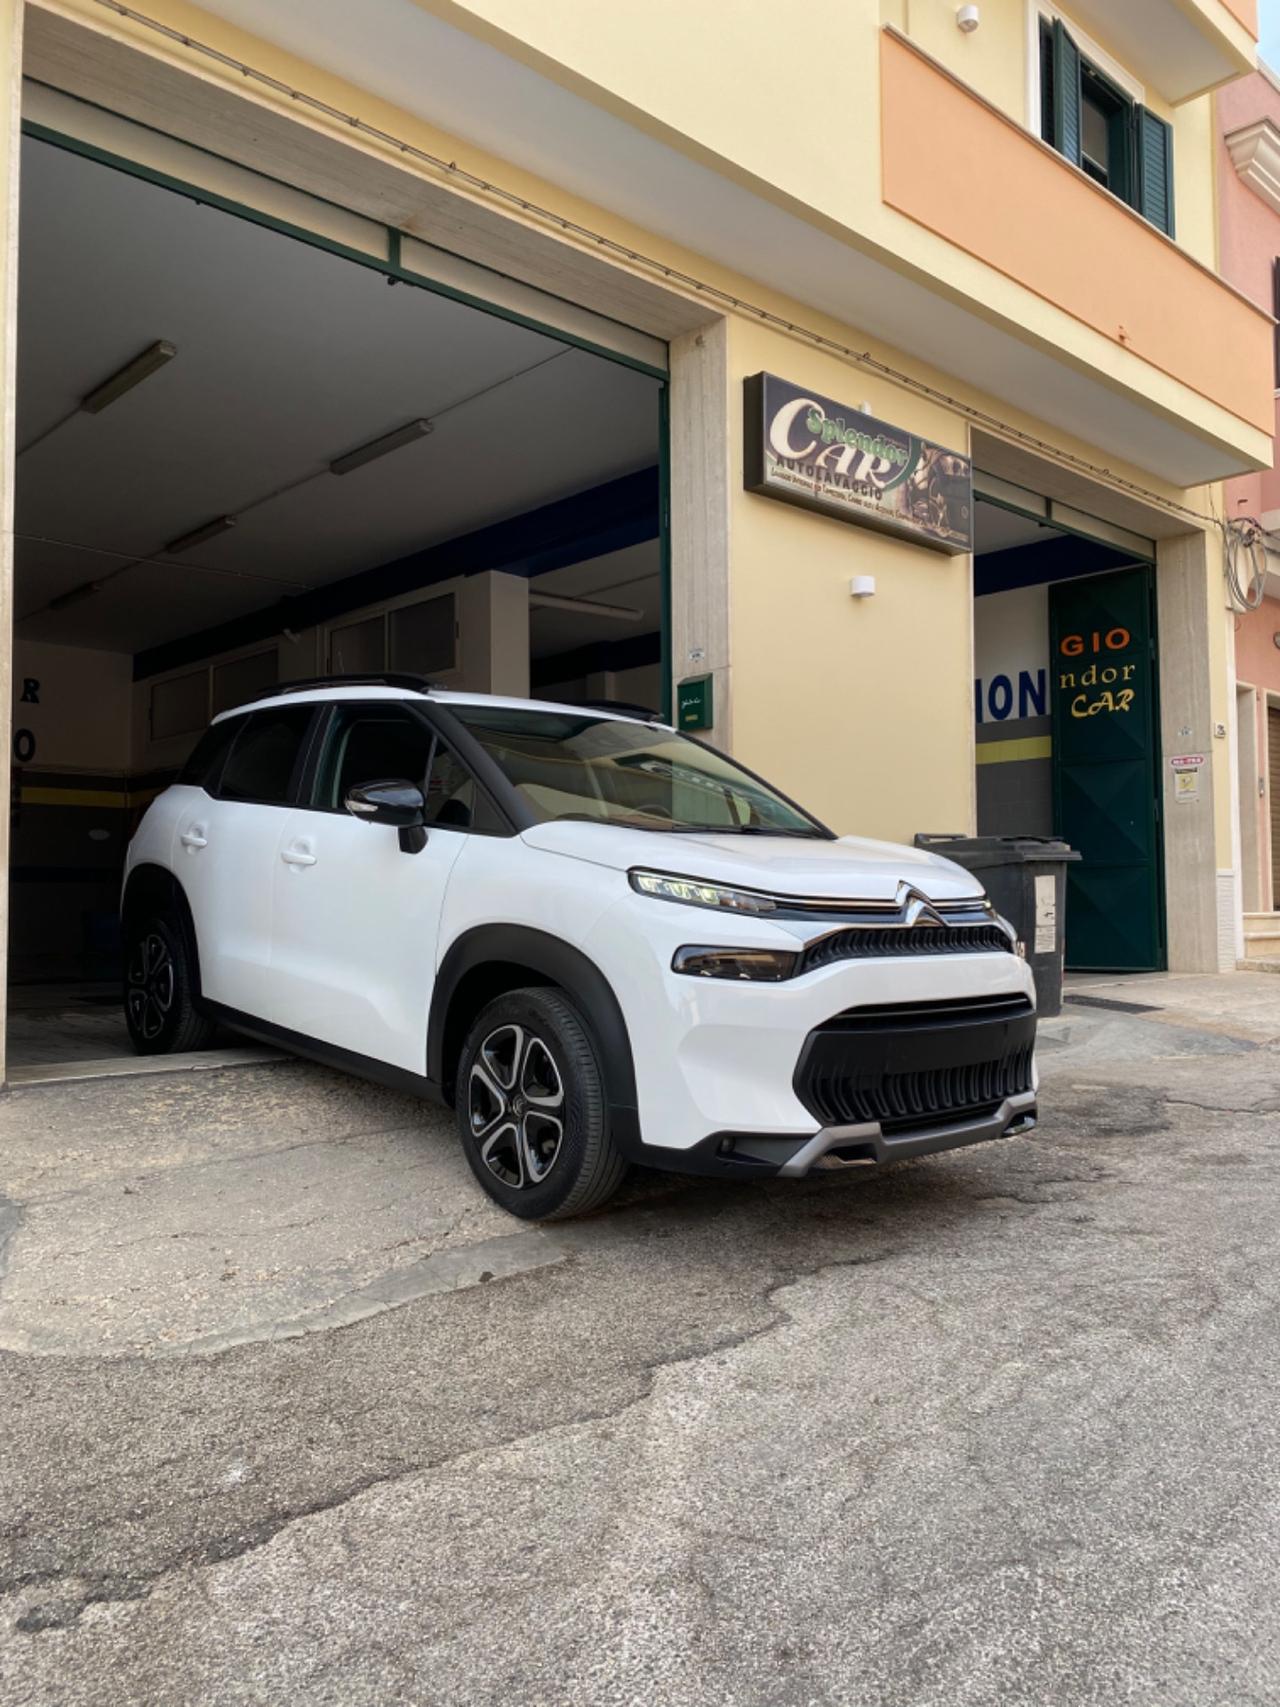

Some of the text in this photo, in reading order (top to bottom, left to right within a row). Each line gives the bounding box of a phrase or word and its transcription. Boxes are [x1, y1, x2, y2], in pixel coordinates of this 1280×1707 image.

[770, 398, 892, 489] CAR
[806, 407, 908, 465] Splendor
[776, 457, 883, 501] AUTOLAVAGGIO
[1060, 628, 1131, 656] GIO
[20, 678, 41, 704] R
[1059, 664, 1136, 689] ndor
[1071, 688, 1136, 718] CAR
